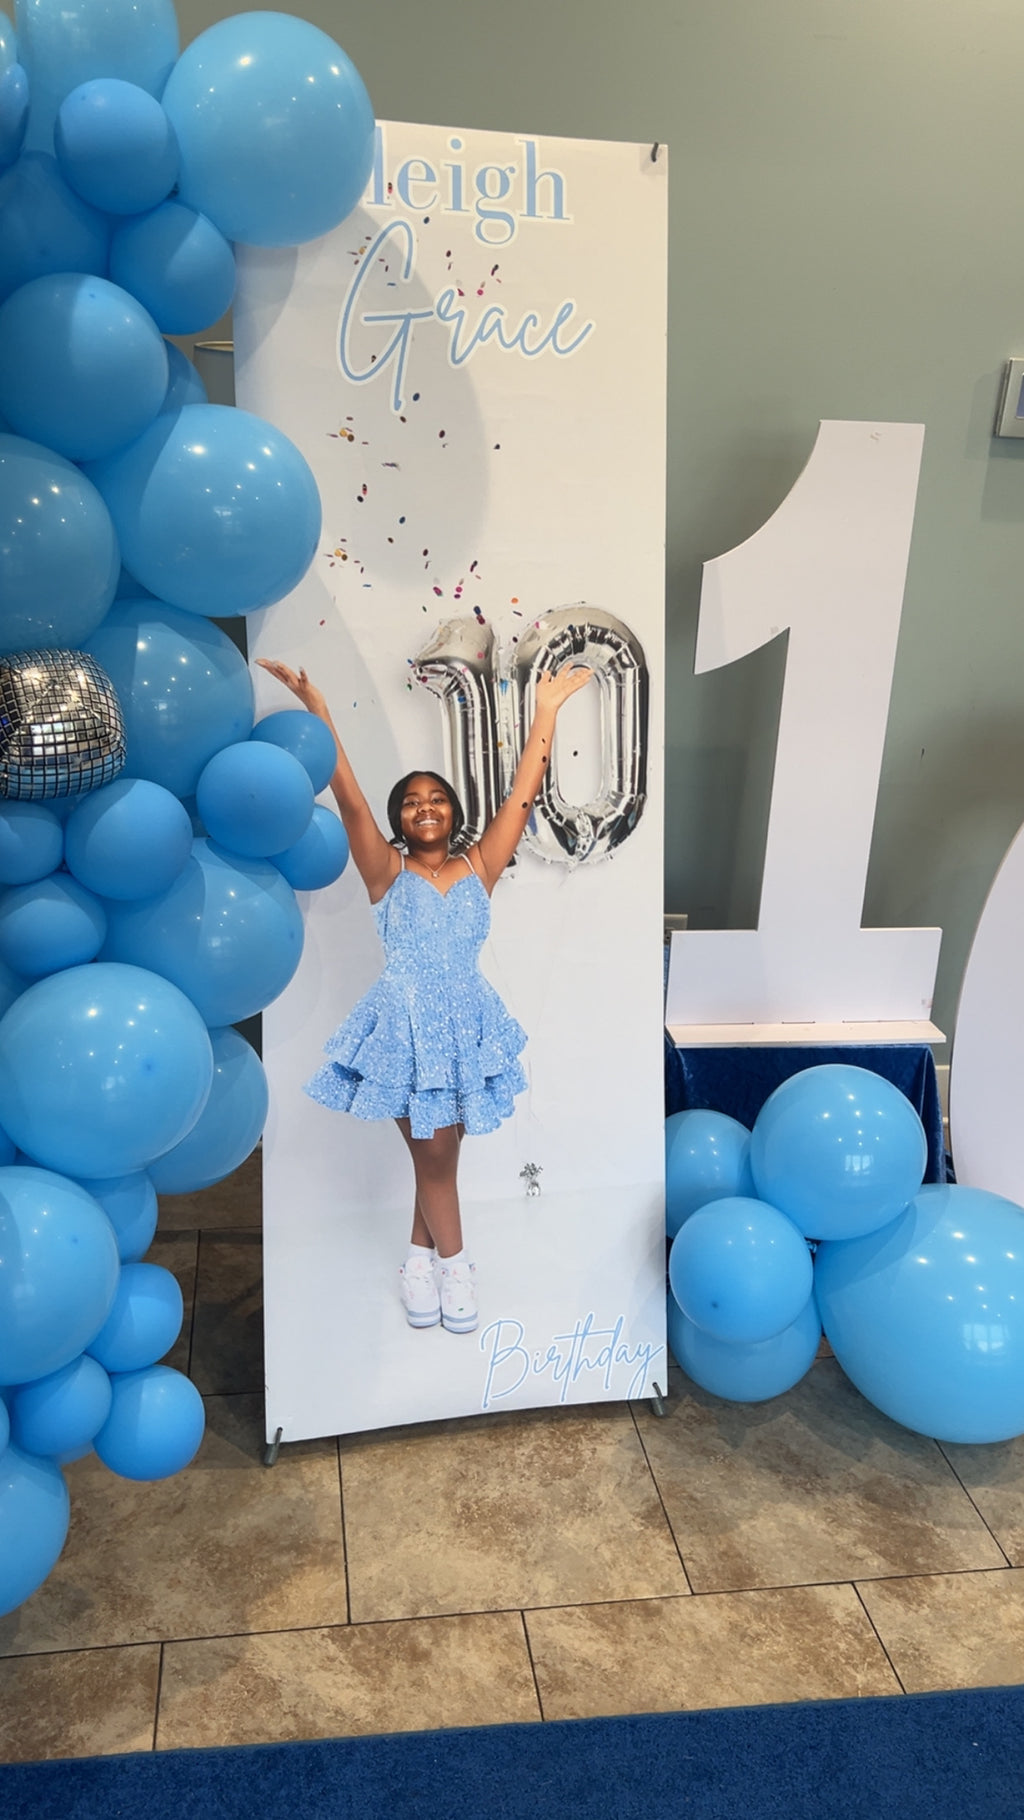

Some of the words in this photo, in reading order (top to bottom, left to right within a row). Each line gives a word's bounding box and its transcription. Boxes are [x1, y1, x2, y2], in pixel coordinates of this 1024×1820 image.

[340, 220, 594, 411] Grace
[411, 601, 650, 868] 10
[480, 1313, 665, 1408] Birthday
